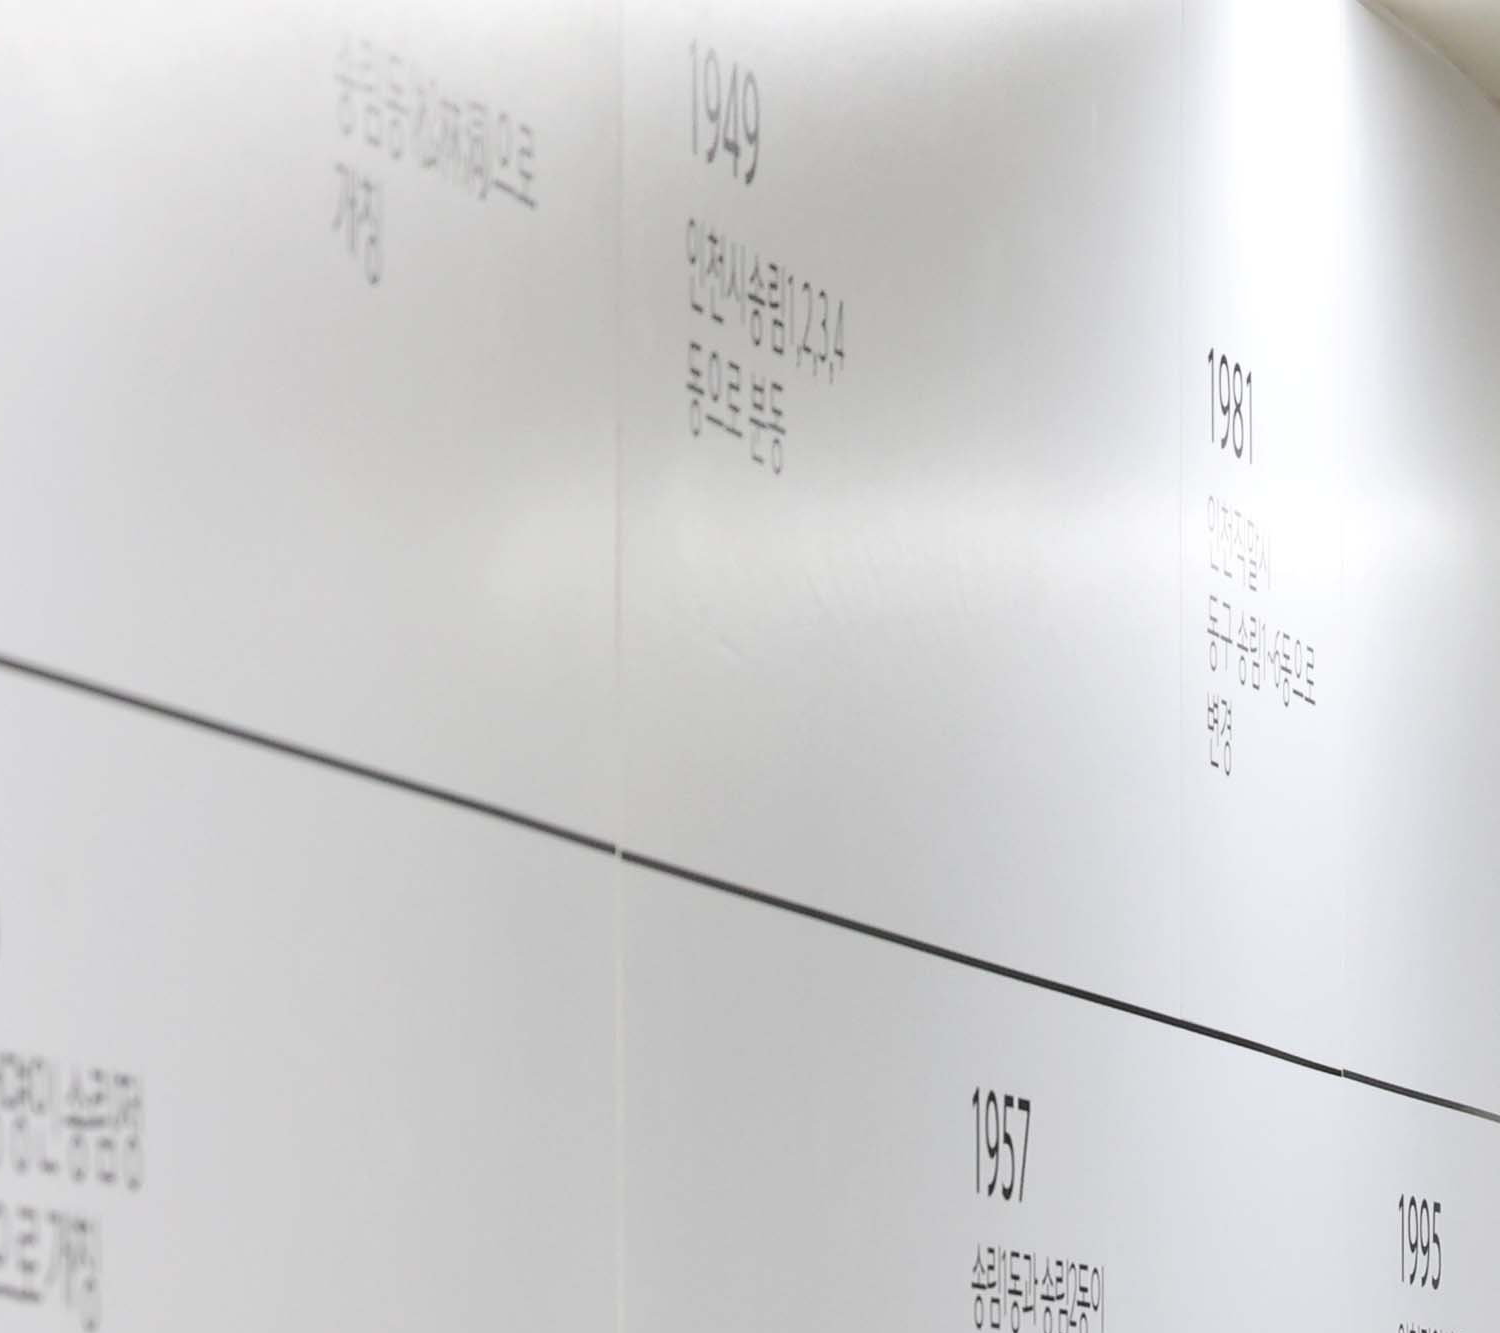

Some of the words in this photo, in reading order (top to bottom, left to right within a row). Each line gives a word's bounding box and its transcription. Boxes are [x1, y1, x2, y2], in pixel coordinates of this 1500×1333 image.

[688, 38, 761, 187] 1949
[686, 341, 743, 438] 동으로
[749, 372, 787, 475] 분동
[1207, 346, 1253, 465] 1981
[1207, 494, 1273, 593] 인천직할시
[1207, 594, 1233, 673] 동구
[1236, 606, 1316, 708] 송림1~6동으로
[1207, 691, 1232, 777] 변경
[972, 1086, 1031, 1202] 1957
[1398, 1194, 1442, 1290] 1995
